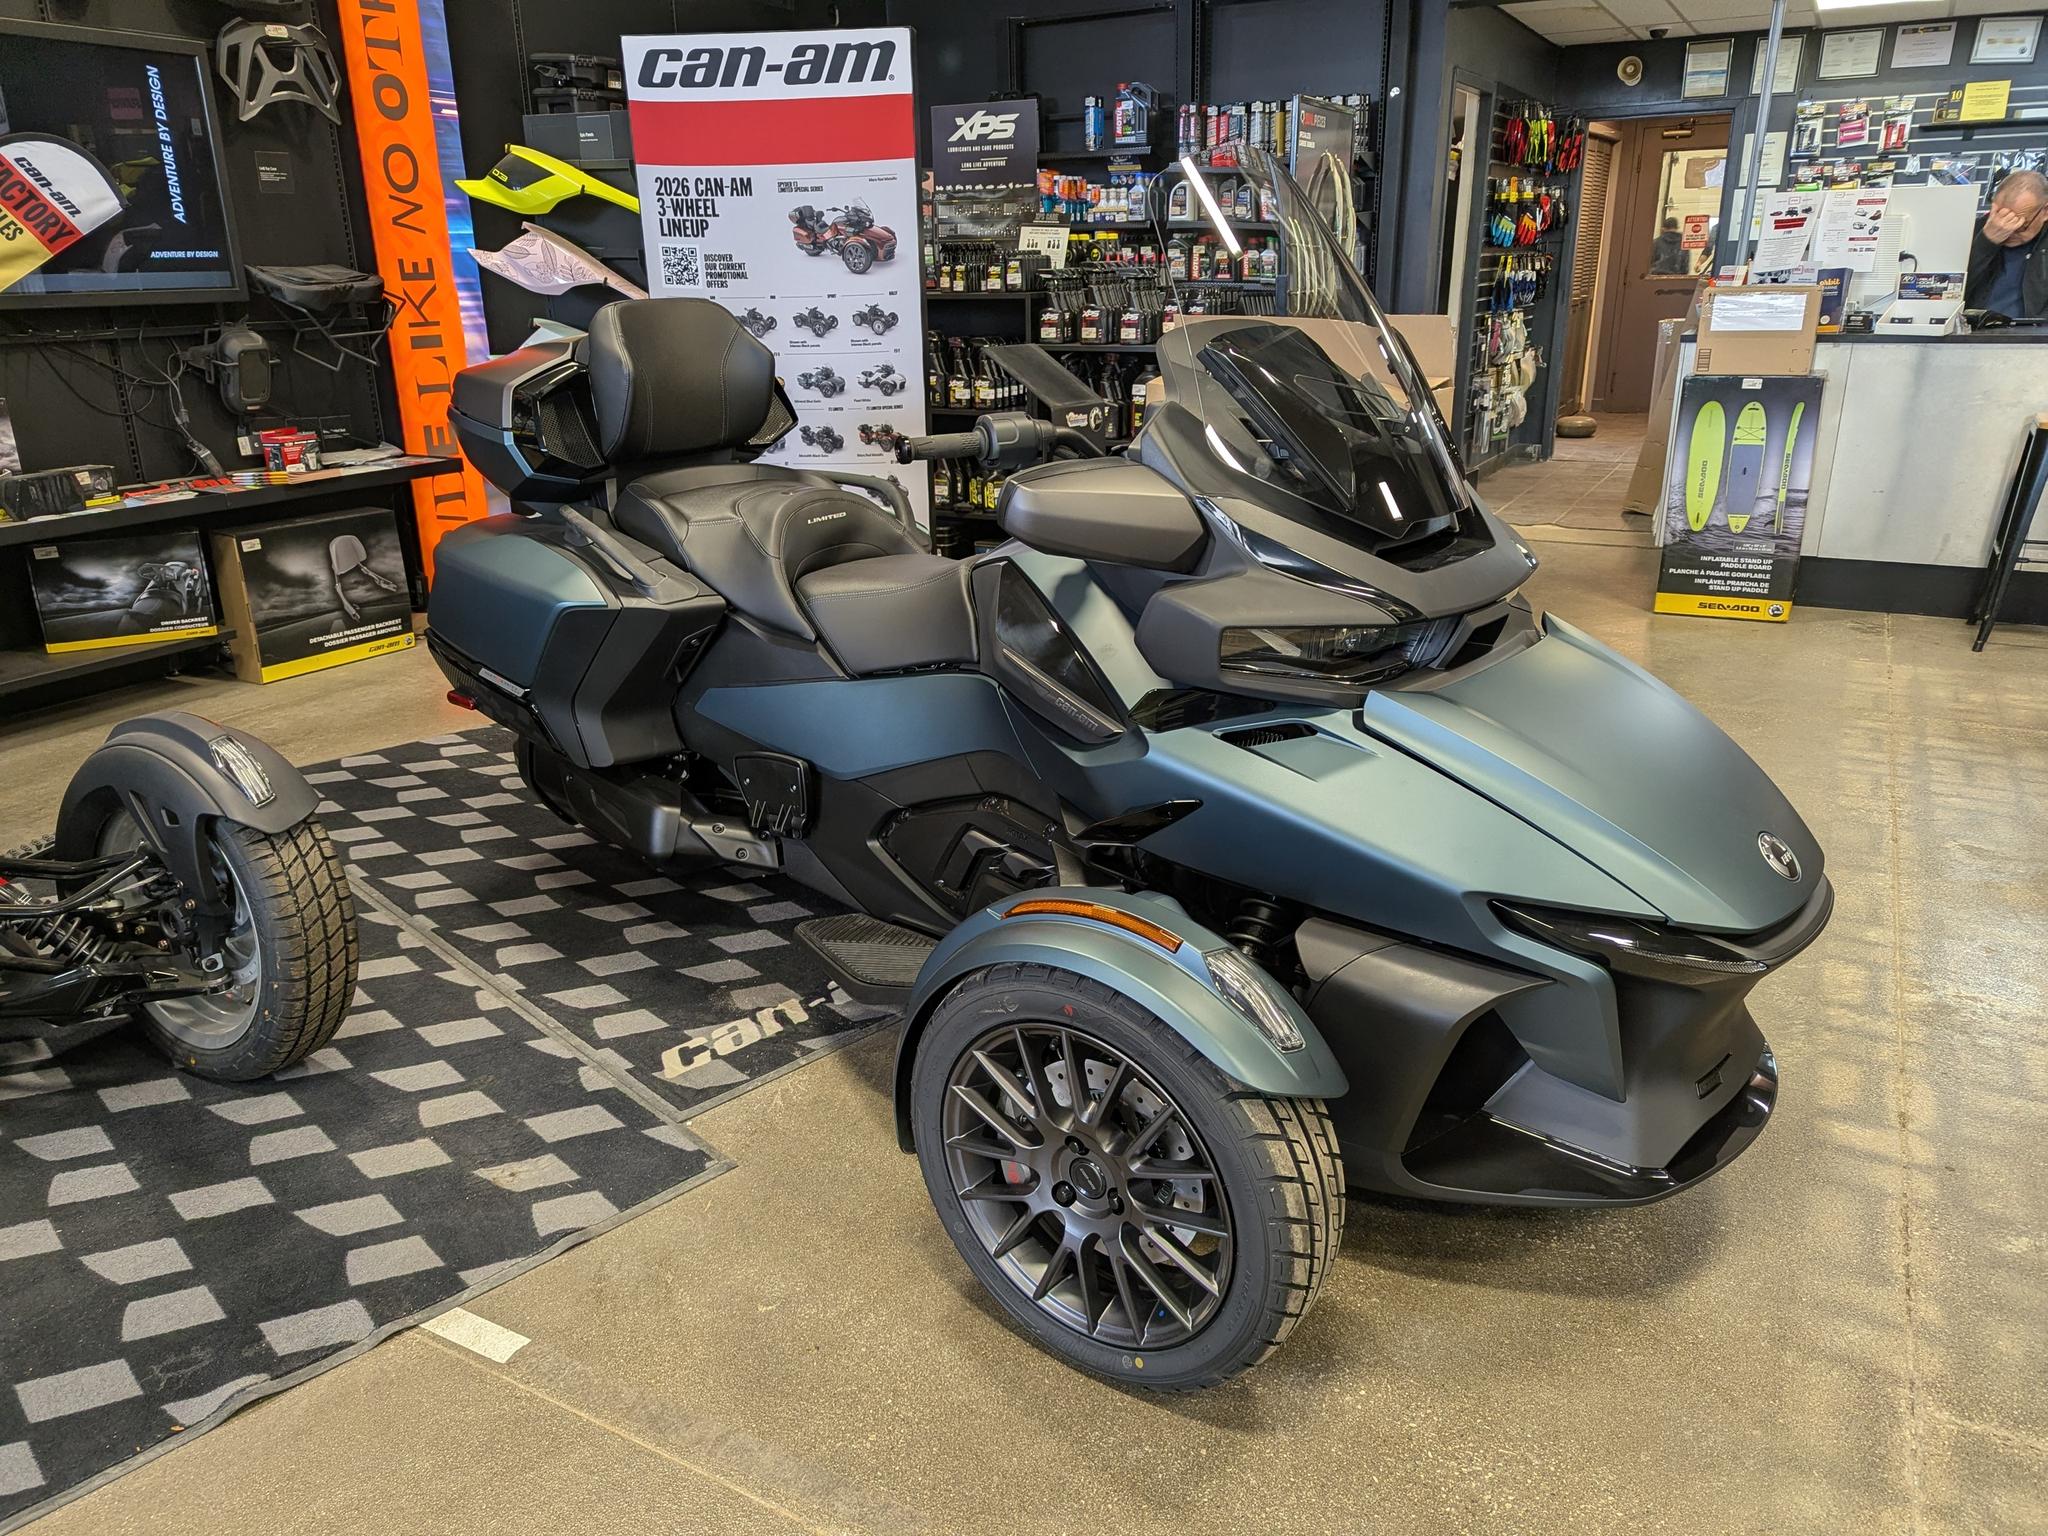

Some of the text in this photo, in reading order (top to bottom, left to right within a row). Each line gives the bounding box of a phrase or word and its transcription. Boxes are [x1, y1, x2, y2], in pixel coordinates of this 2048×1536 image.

[638, 40, 896, 88] can-am
[947, 110, 1020, 142] XPS
[146, 65, 187, 224] ADVENTURE BY DESIGN
[983, 160, 1006, 168] ADVENTURE
[14, 156, 81, 218] can-am
[383, 144, 426, 234] NO
[655, 176, 752, 197] 2026 CAN-AM
[0, 158, 75, 245] ACTORY
[658, 198, 720, 218] 3-WHEEL
[660, 218, 710, 238] LINEUP
[196, 250, 218, 258] DESIGN
[704, 254, 733, 262] DISCOVER
[704, 262, 746, 271] OUR CURRENT
[706, 271, 748, 280] PROMOTIONAL
[706, 280, 728, 288] OFFERS
[398, 258, 452, 400] LIKE
[423, 422, 468, 521] IDE
[808, 512, 847, 524] LIMITED
[1726, 580, 1758, 588] PRANCHA
[181, 616, 208, 624] BACKREST
[309, 618, 402, 644] DETACHABLE PASSENGER BACKREST
[324, 625, 402, 648] DOSSIER PASSAGER AMOVIBLE
[368, 641, 400, 652] can-am
